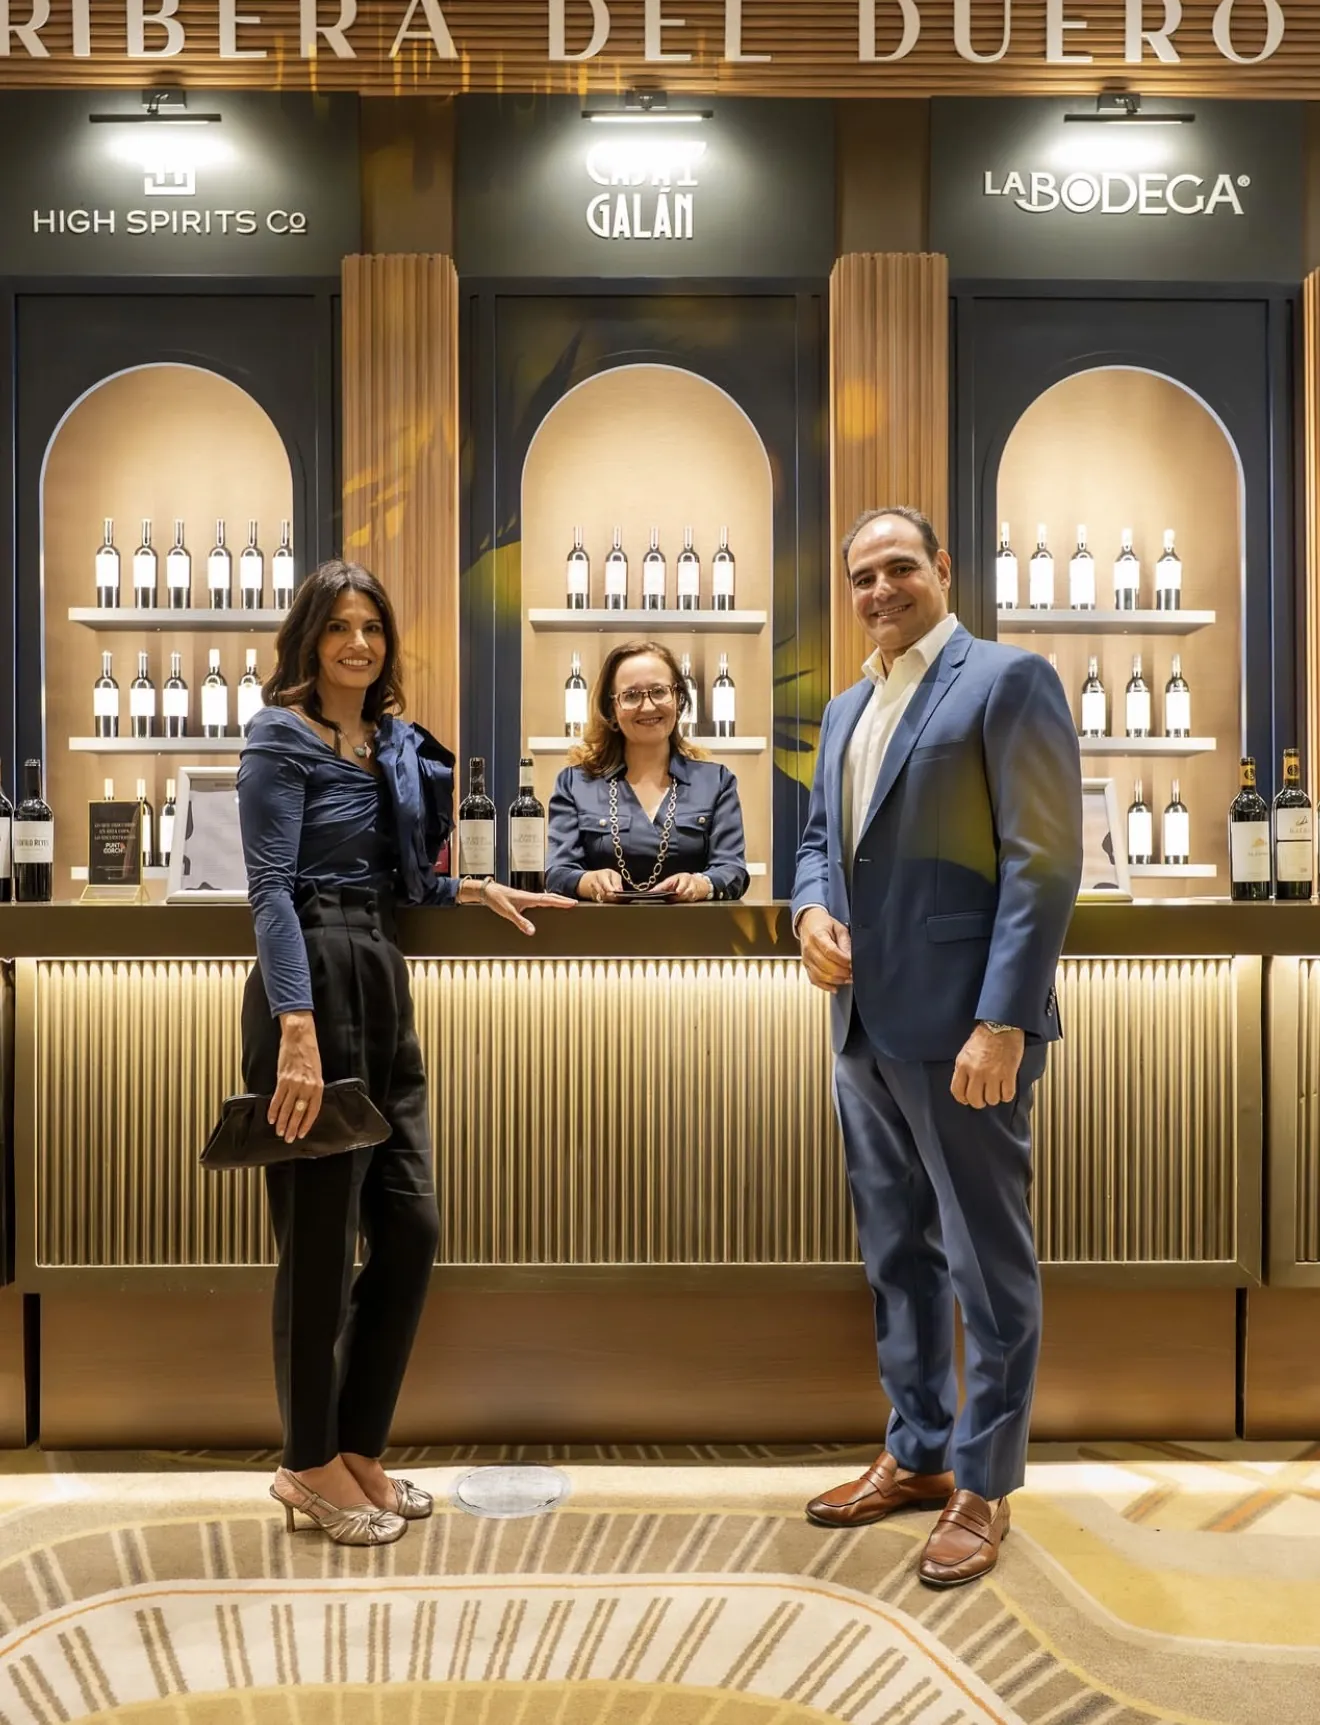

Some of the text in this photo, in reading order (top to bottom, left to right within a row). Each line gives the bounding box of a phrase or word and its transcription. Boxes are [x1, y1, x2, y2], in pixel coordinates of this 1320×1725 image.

[0, 0, 1286, 64] RIBERA DEL DUERO
[32, 209, 116, 235] HIGH
[126, 209, 258, 235] SPIRITS
[586, 187, 694, 240] GALÁN
